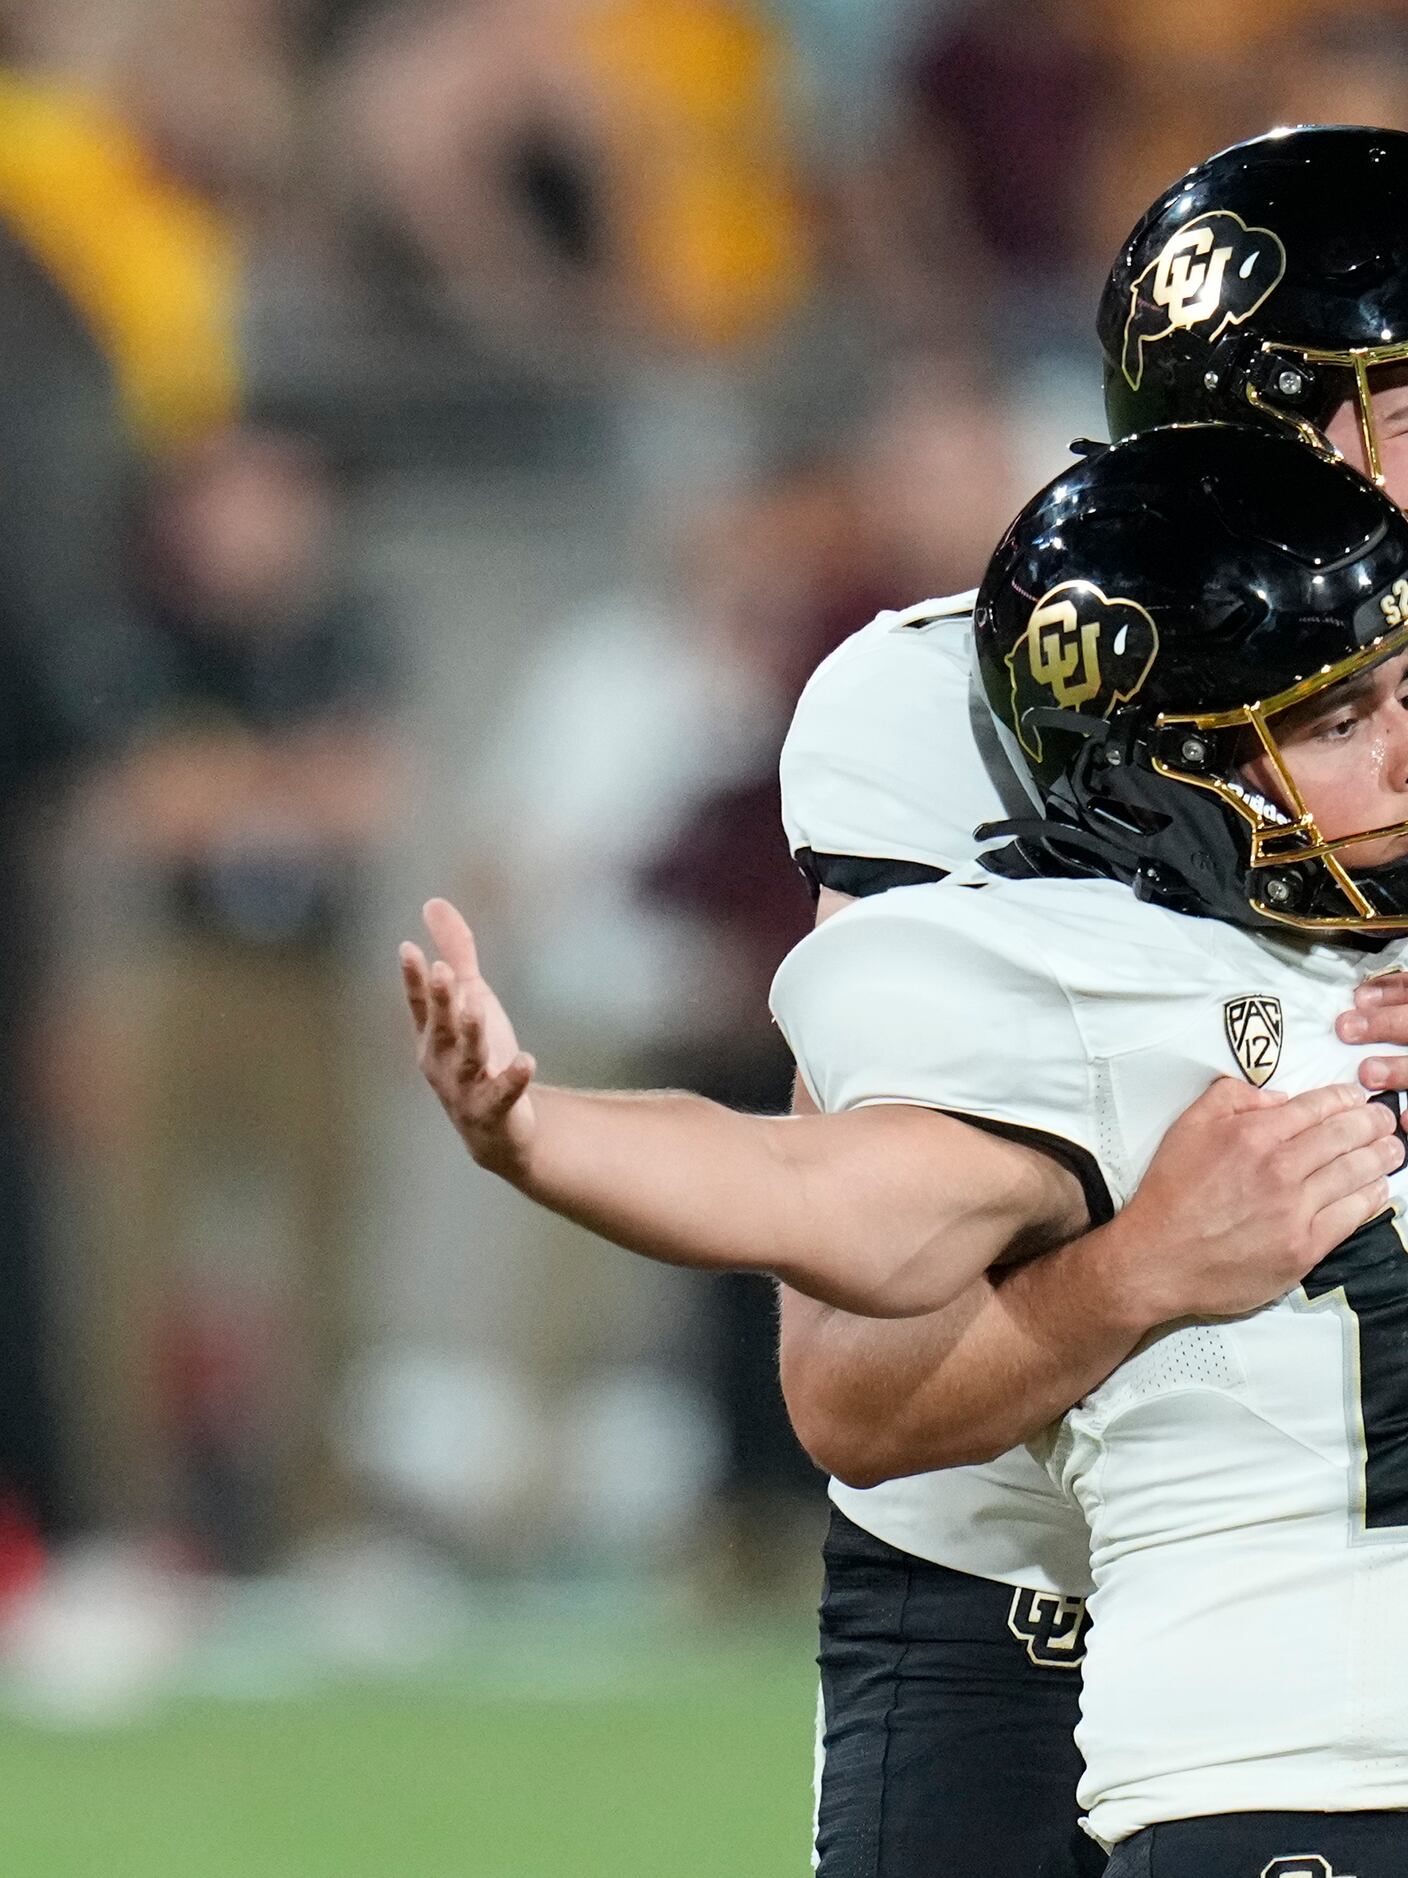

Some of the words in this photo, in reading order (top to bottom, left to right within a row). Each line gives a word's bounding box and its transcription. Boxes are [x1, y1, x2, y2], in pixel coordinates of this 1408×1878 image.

[1153, 226, 1233, 325] CU
[1028, 599, 1102, 709] CU
[1229, 1000, 1280, 1053] PAC
[1246, 1036, 1273, 1069] 12
